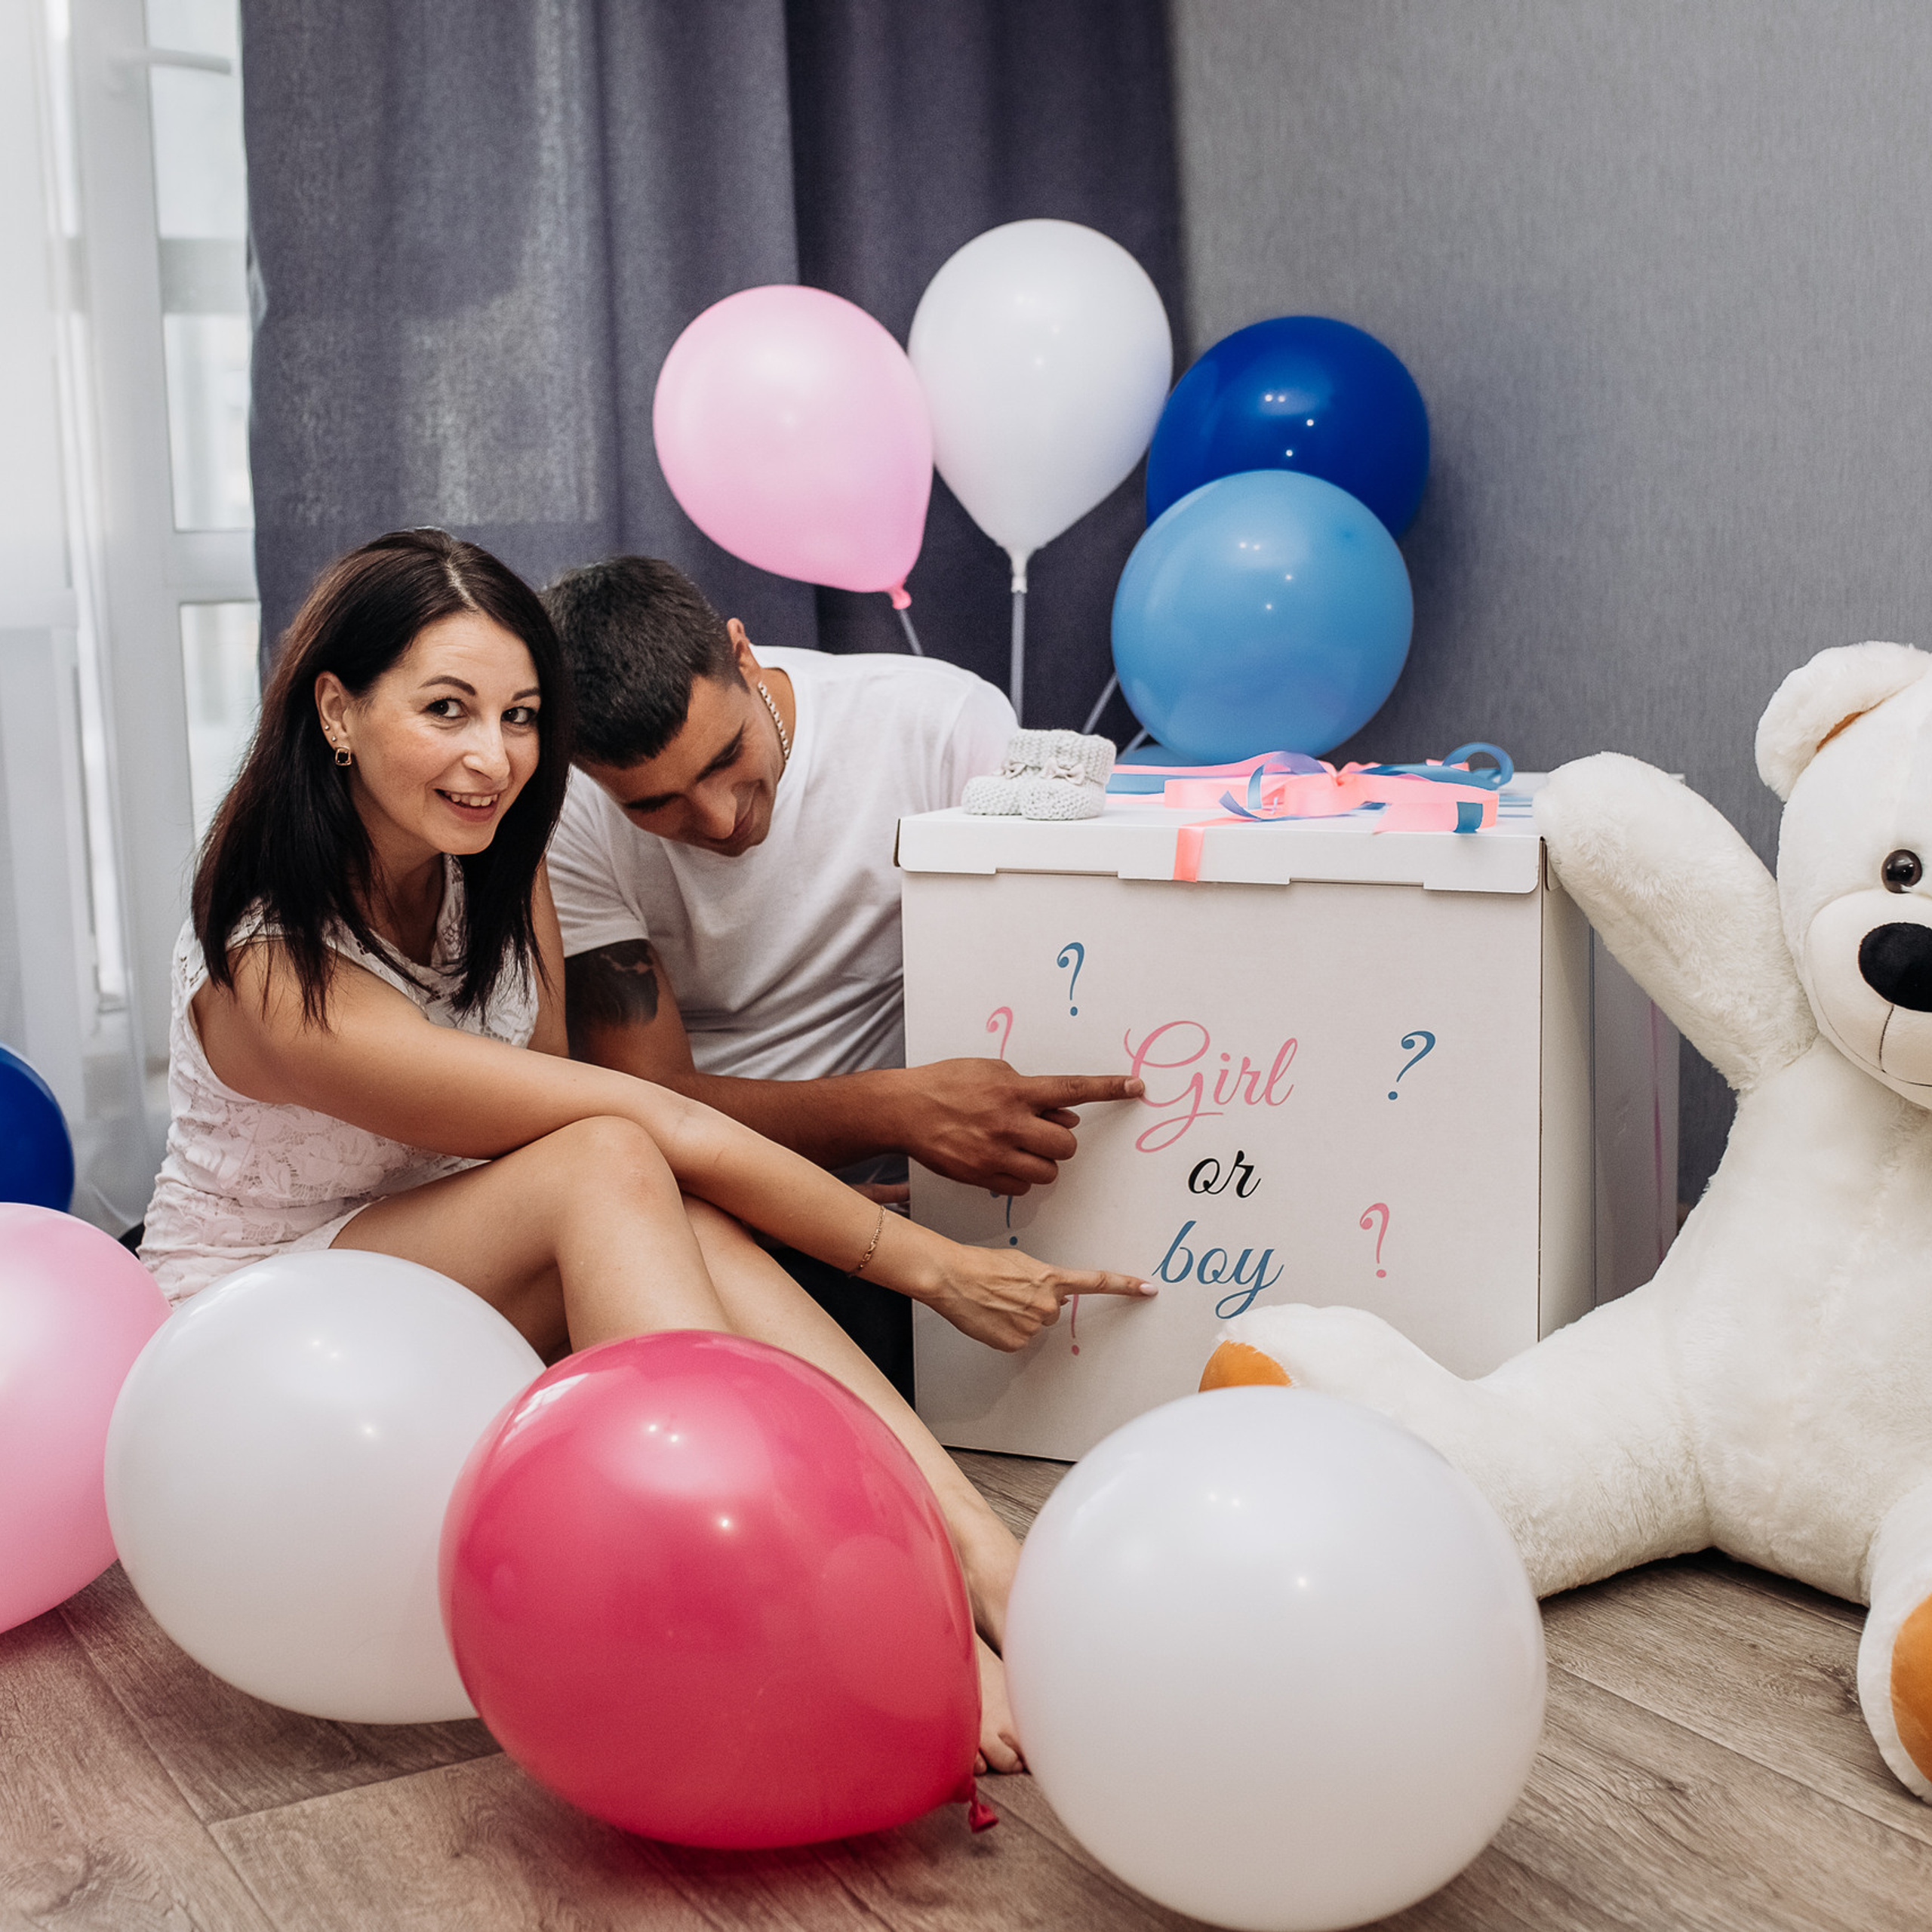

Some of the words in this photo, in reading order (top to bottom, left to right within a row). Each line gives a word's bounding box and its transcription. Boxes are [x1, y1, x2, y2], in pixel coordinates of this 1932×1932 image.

[1057, 942, 1084, 1017] ?
[1124, 1020, 1297, 1152] Girl
[1388, 1030, 1436, 1100] ?
[1188, 1149, 1262, 1198] or
[1152, 1220, 1284, 1319] boy
[1359, 1203, 1390, 1278] ?
